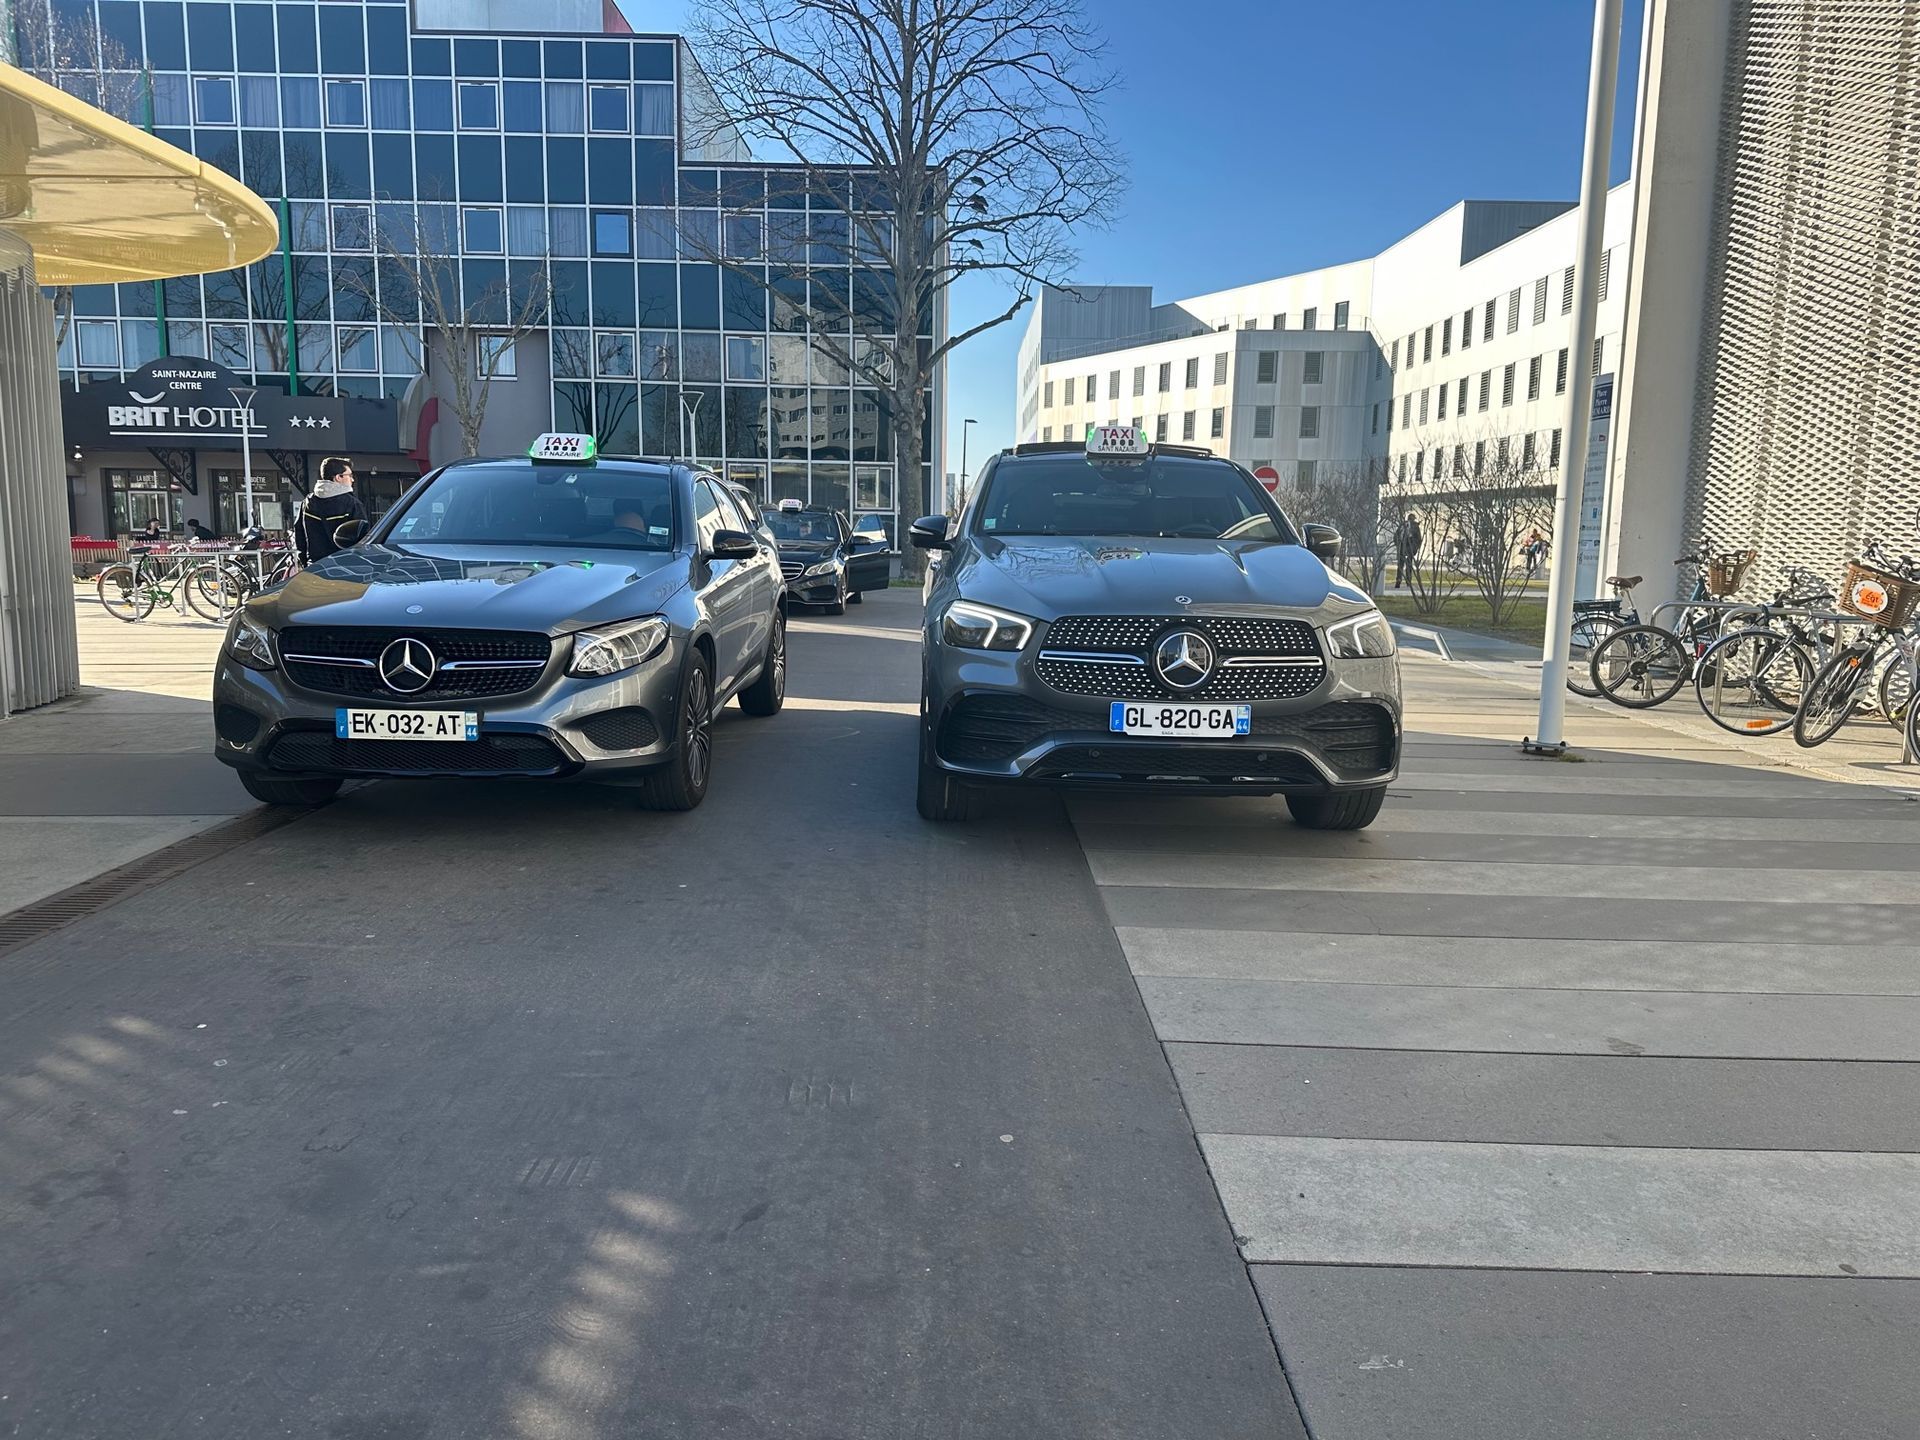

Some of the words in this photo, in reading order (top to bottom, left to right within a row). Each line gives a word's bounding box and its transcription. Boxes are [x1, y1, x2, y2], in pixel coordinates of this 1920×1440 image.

[152, 370, 217, 379] SAINT-NAZAIRE
[169, 381, 202, 390] CENTRE
[108, 406, 169, 427] BRIT
[173, 406, 267, 429] HOTEL
[1100, 428, 1134, 439] TAXI
[544, 436, 580, 446] TAXI
[1125, 707, 1234, 729] GL-820-GA
[352, 713, 460, 735] EK-032-AT
[1237, 722, 1248, 731] 44
[466, 728, 477, 737] 44
